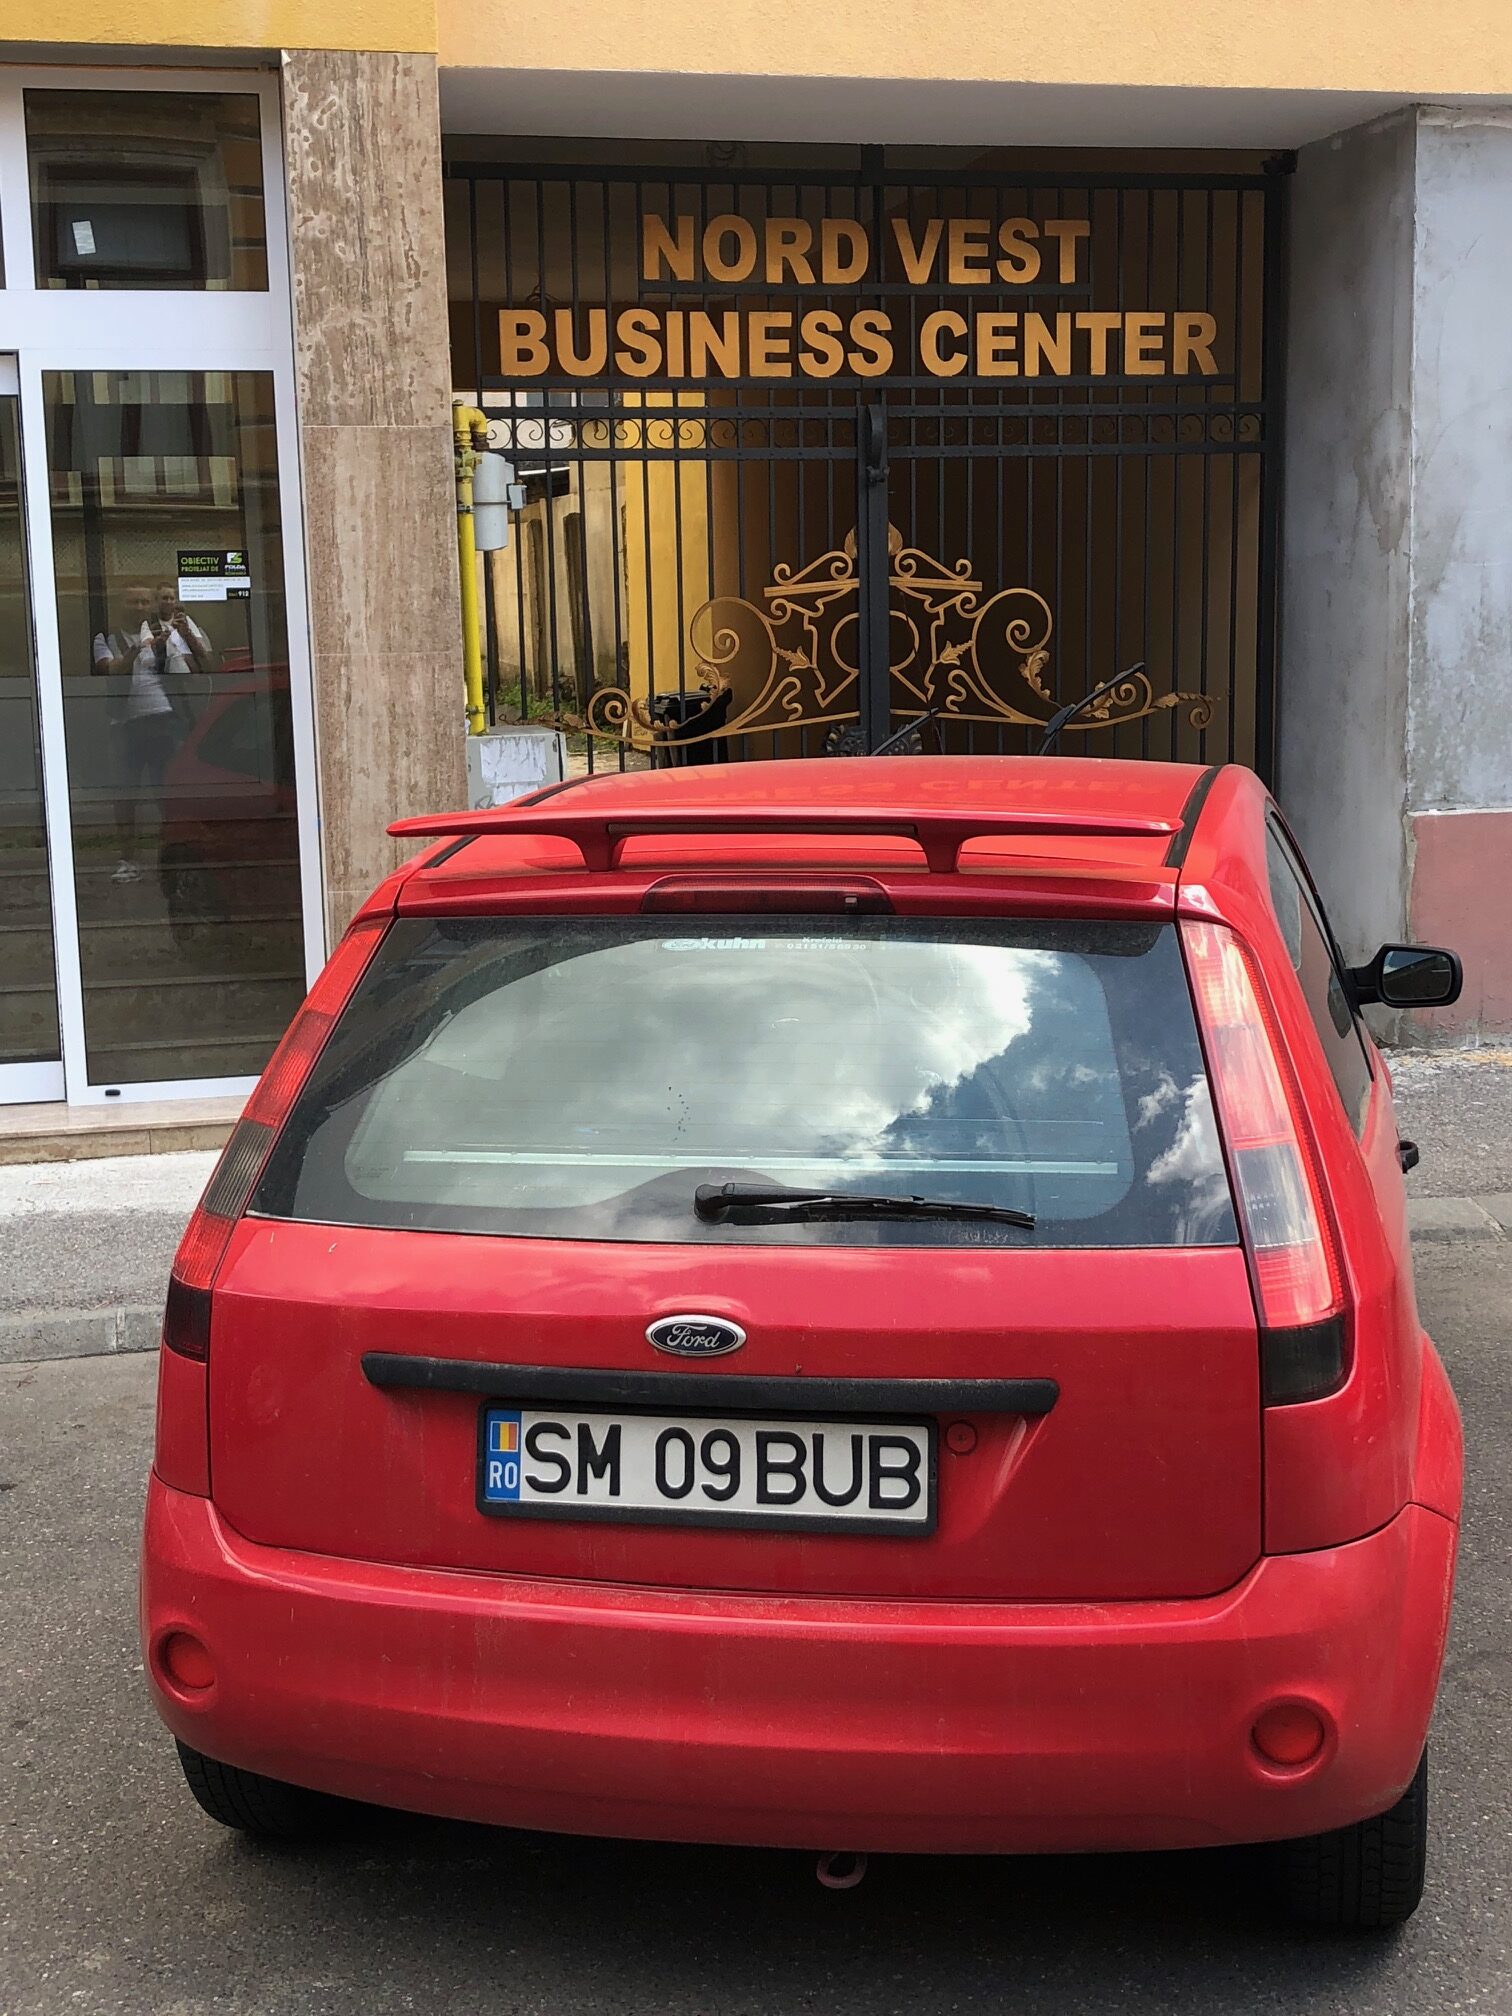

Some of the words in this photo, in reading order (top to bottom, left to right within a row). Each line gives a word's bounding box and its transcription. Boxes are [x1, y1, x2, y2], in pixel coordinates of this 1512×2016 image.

[643, 213, 870, 286] NORD
[891, 216, 1091, 285] VEST
[499, 308, 894, 379] BUSINESS
[919, 310, 1220, 379] CENTER
[181, 557, 219, 565] OBIECTIV
[700, 937, 766, 950] kuhn
[666, 1323, 721, 1348] Ford
[489, 1460, 518, 1489] RO
[524, 1421, 622, 1497] SM
[654, 1426, 741, 1501] 09
[755, 1430, 922, 1510] BUB
